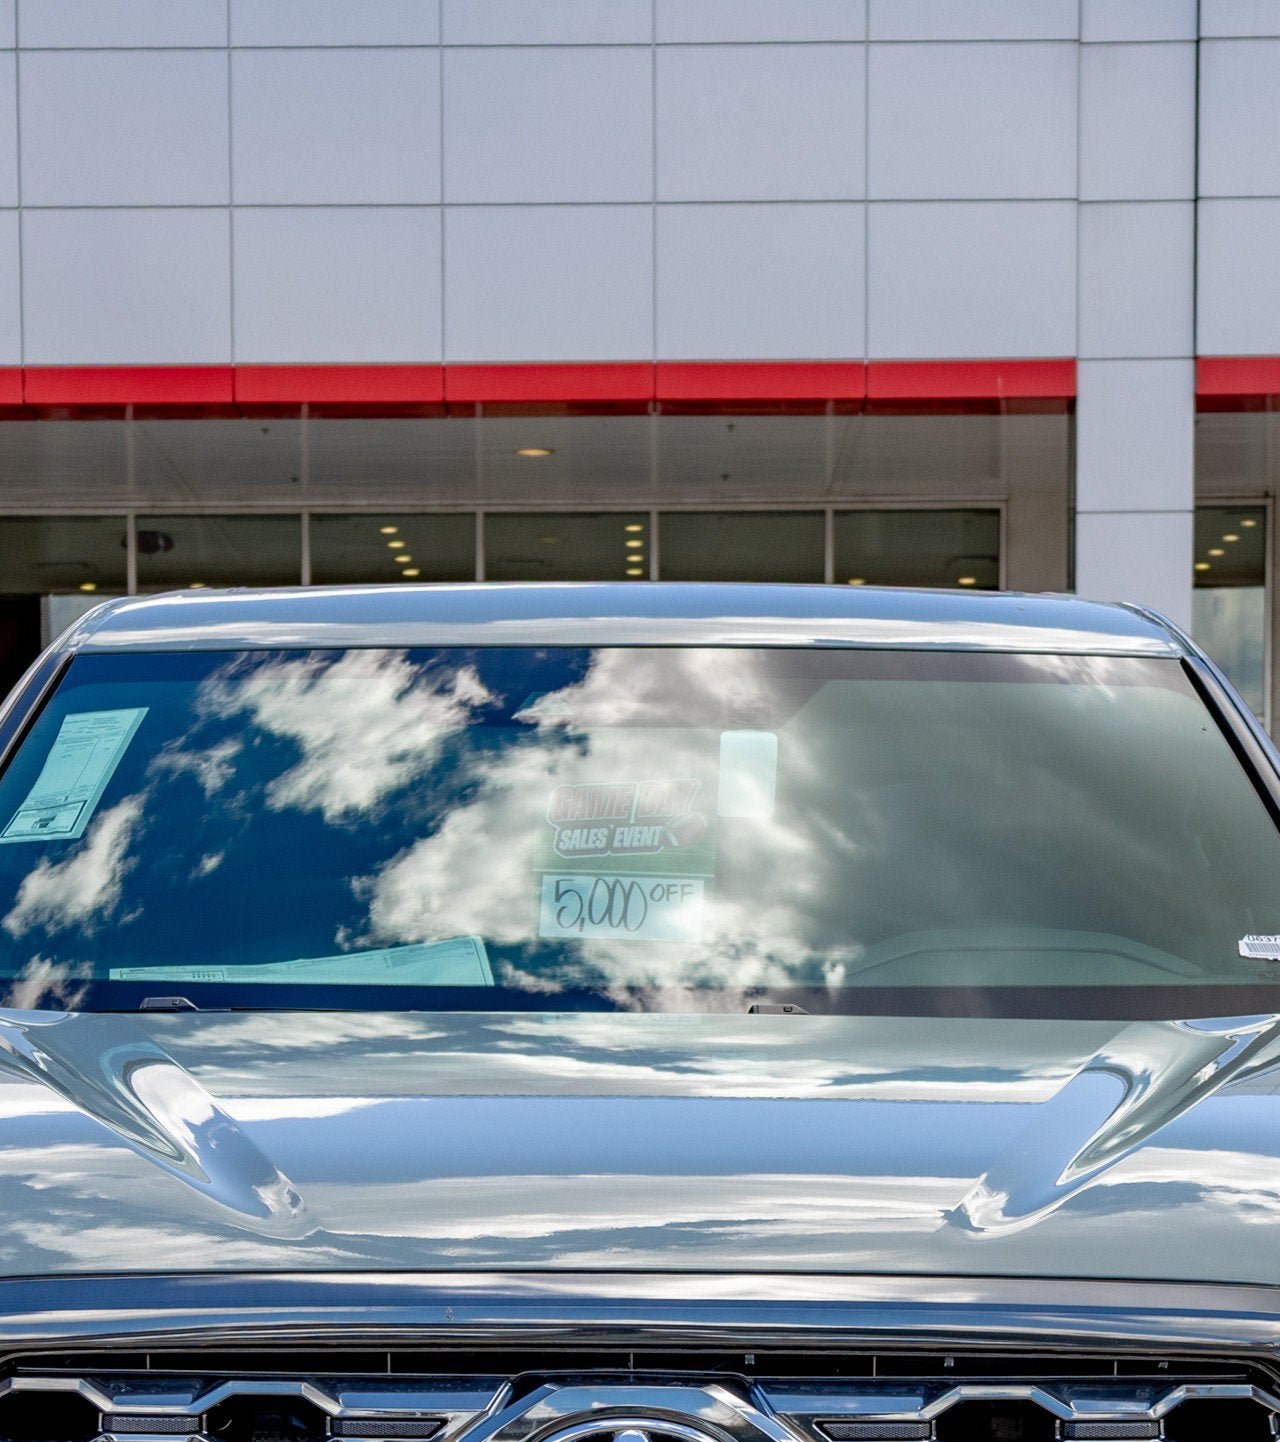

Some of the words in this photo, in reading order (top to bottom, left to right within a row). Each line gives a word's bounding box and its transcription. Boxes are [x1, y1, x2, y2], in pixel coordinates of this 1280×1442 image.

[551, 784, 633, 821] GAME
[637, 779, 700, 817] DAY
[558, 826, 610, 851] SALES
[613, 824, 666, 848] EVENT
[554, 876, 649, 933] 5,000
[648, 883, 695, 904] OFF
